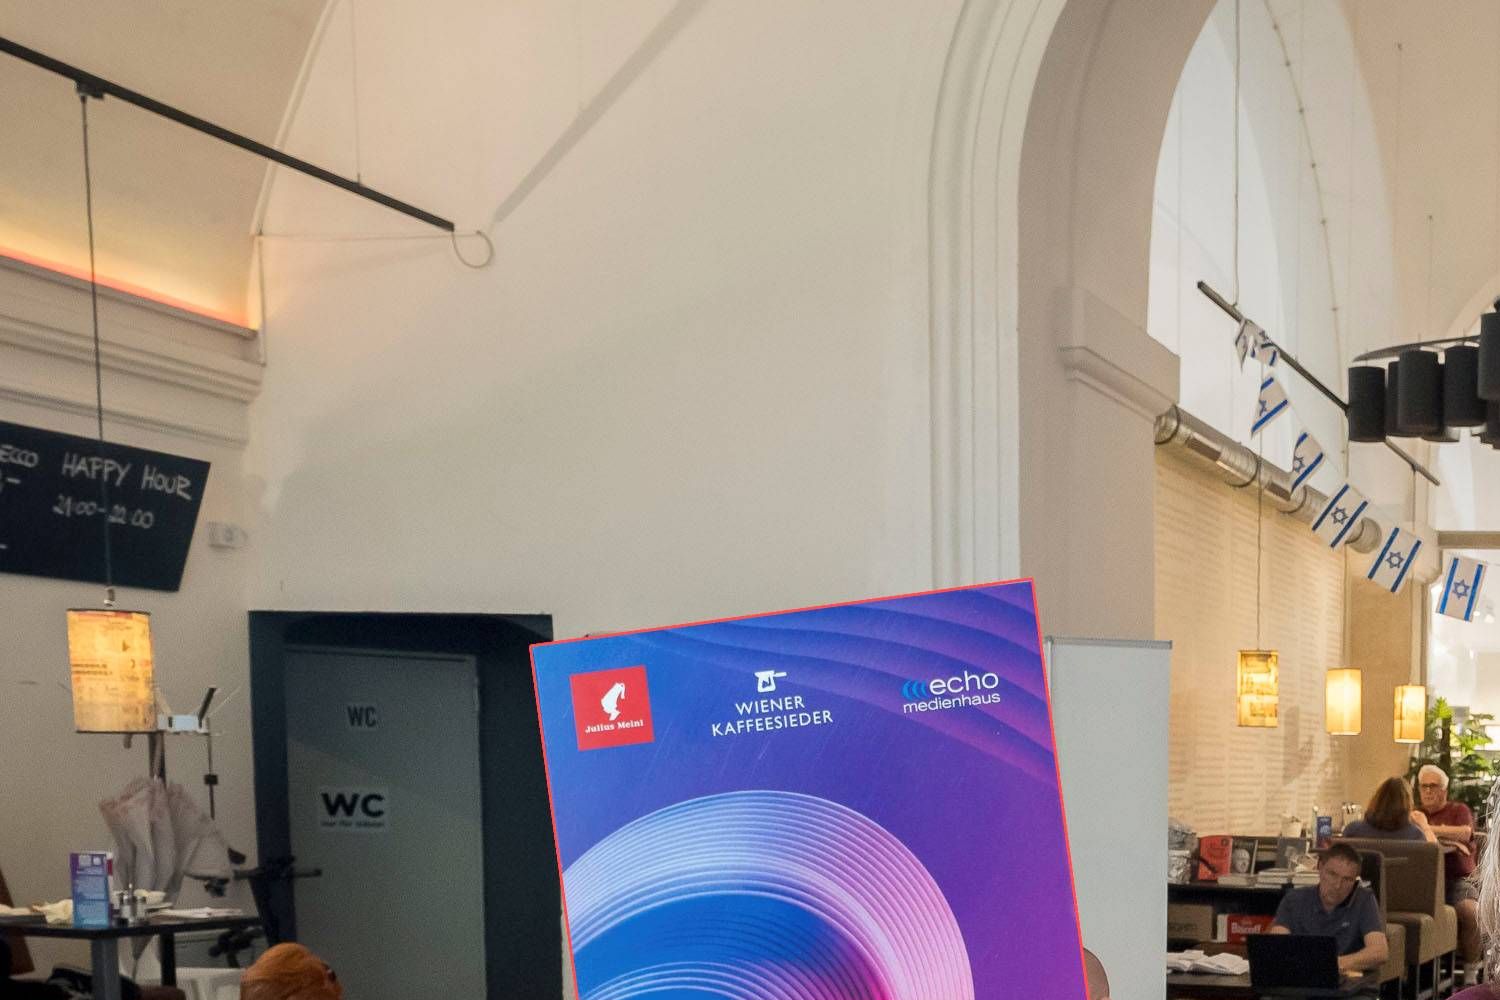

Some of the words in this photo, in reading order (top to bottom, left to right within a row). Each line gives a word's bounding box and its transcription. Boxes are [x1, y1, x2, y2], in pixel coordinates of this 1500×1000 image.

[61, 452, 132, 486] HAPPY
[141, 465, 192, 500] HOUR
[929, 670, 999, 695] echo
[735, 695, 805, 716] WIENER
[903, 692, 1001, 714] medienhaus
[346, 706, 376, 727] WC
[585, 722, 615, 734] Julius
[617, 719, 644, 731] Meinl
[711, 710, 834, 737] KAFFEESIEDER
[321, 793, 384, 818] WC
